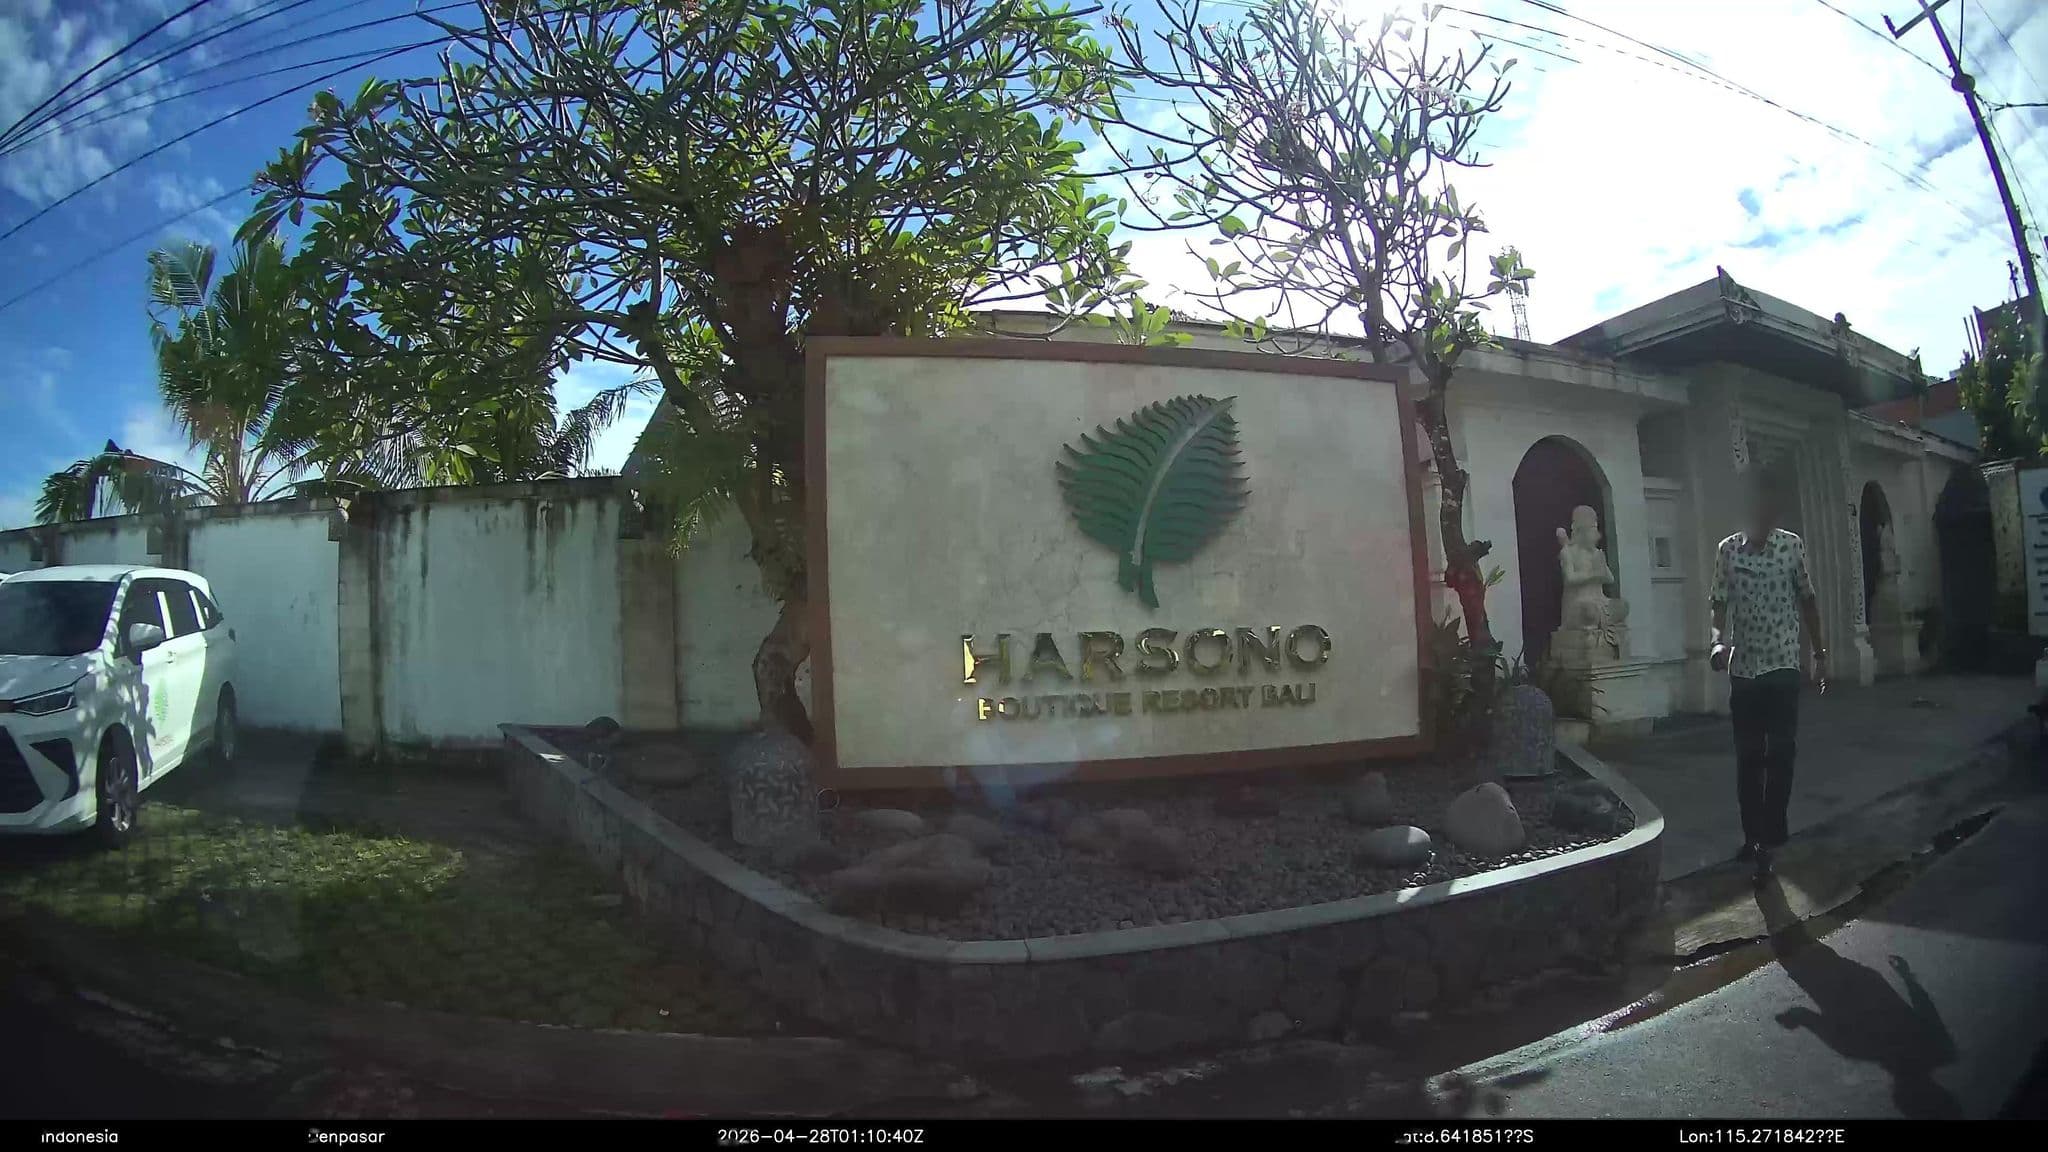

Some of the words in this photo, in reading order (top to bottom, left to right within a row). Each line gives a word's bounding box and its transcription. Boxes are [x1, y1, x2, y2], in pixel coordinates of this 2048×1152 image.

[961, 625, 1331, 683] HARSONO
[978, 692, 1132, 720] BOUTIQUE
[1143, 687, 1253, 714] RESORT
[1262, 682, 1316, 708] BALI
